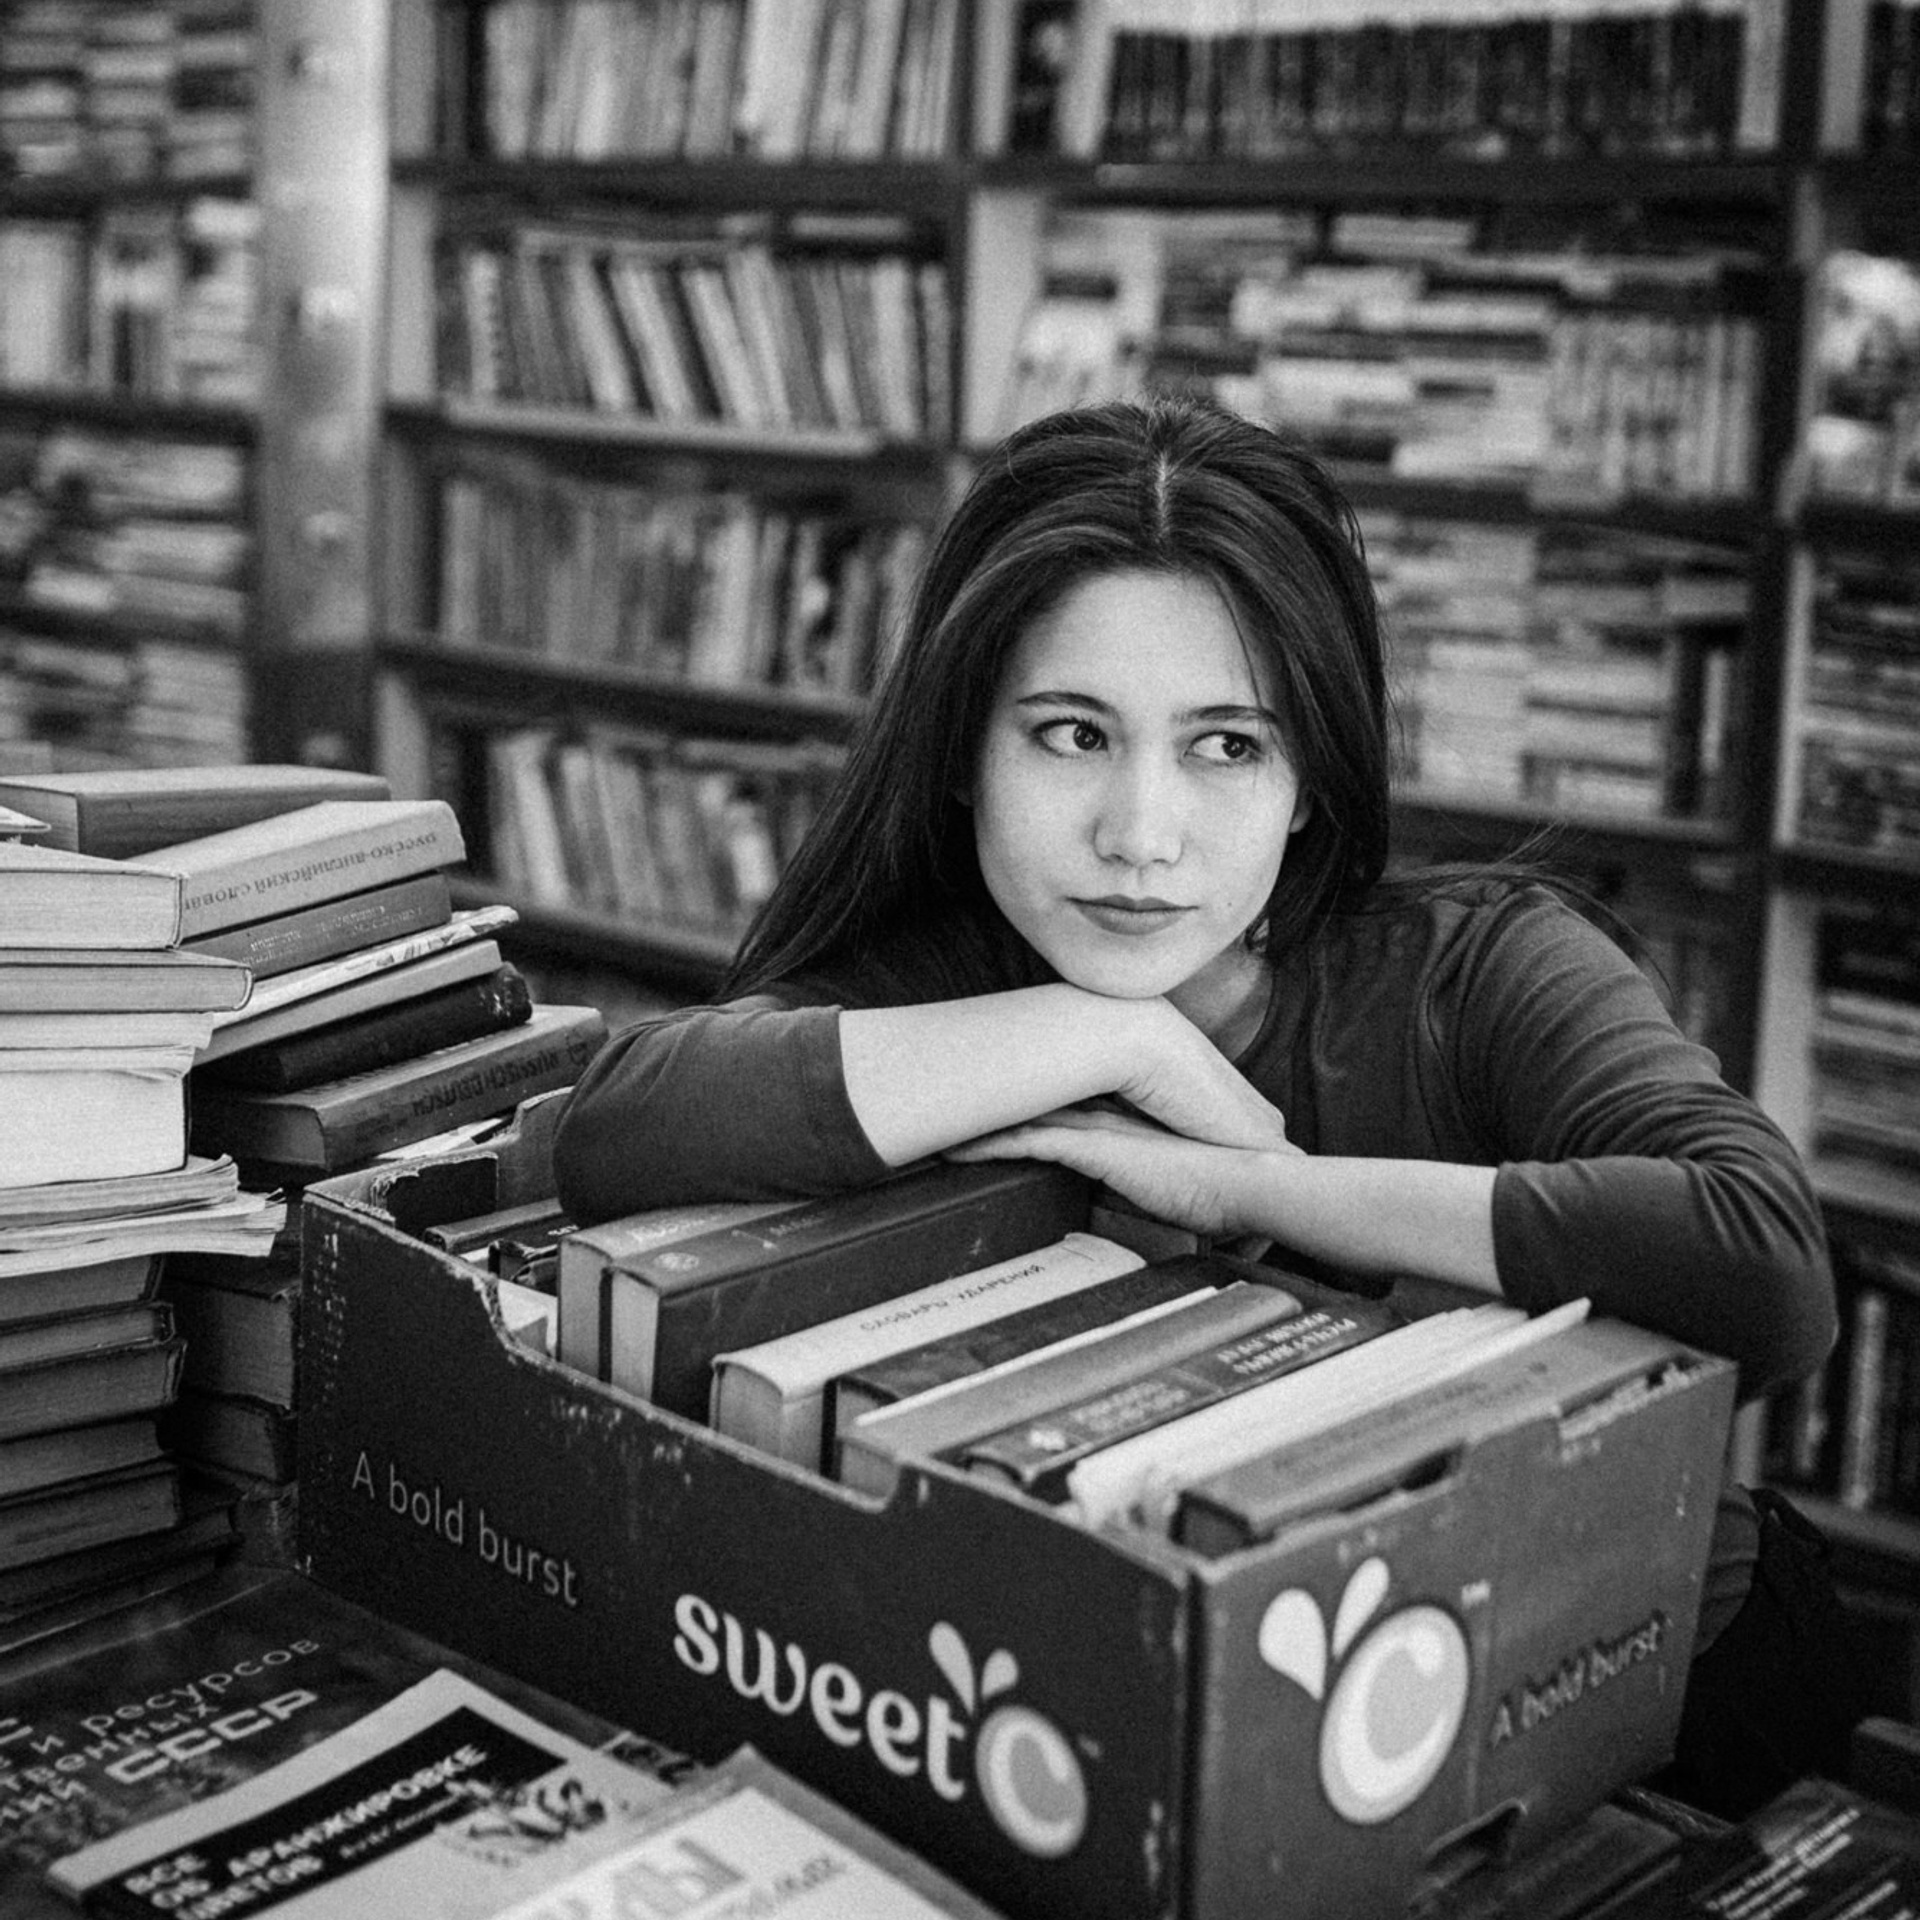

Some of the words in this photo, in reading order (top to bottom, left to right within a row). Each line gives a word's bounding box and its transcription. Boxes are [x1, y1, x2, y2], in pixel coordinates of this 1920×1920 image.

[352, 1450, 375, 1499] A
[389, 1461, 464, 1546] bold
[479, 1507, 578, 1606] burst
[104, 1688, 318, 1784] СССР
